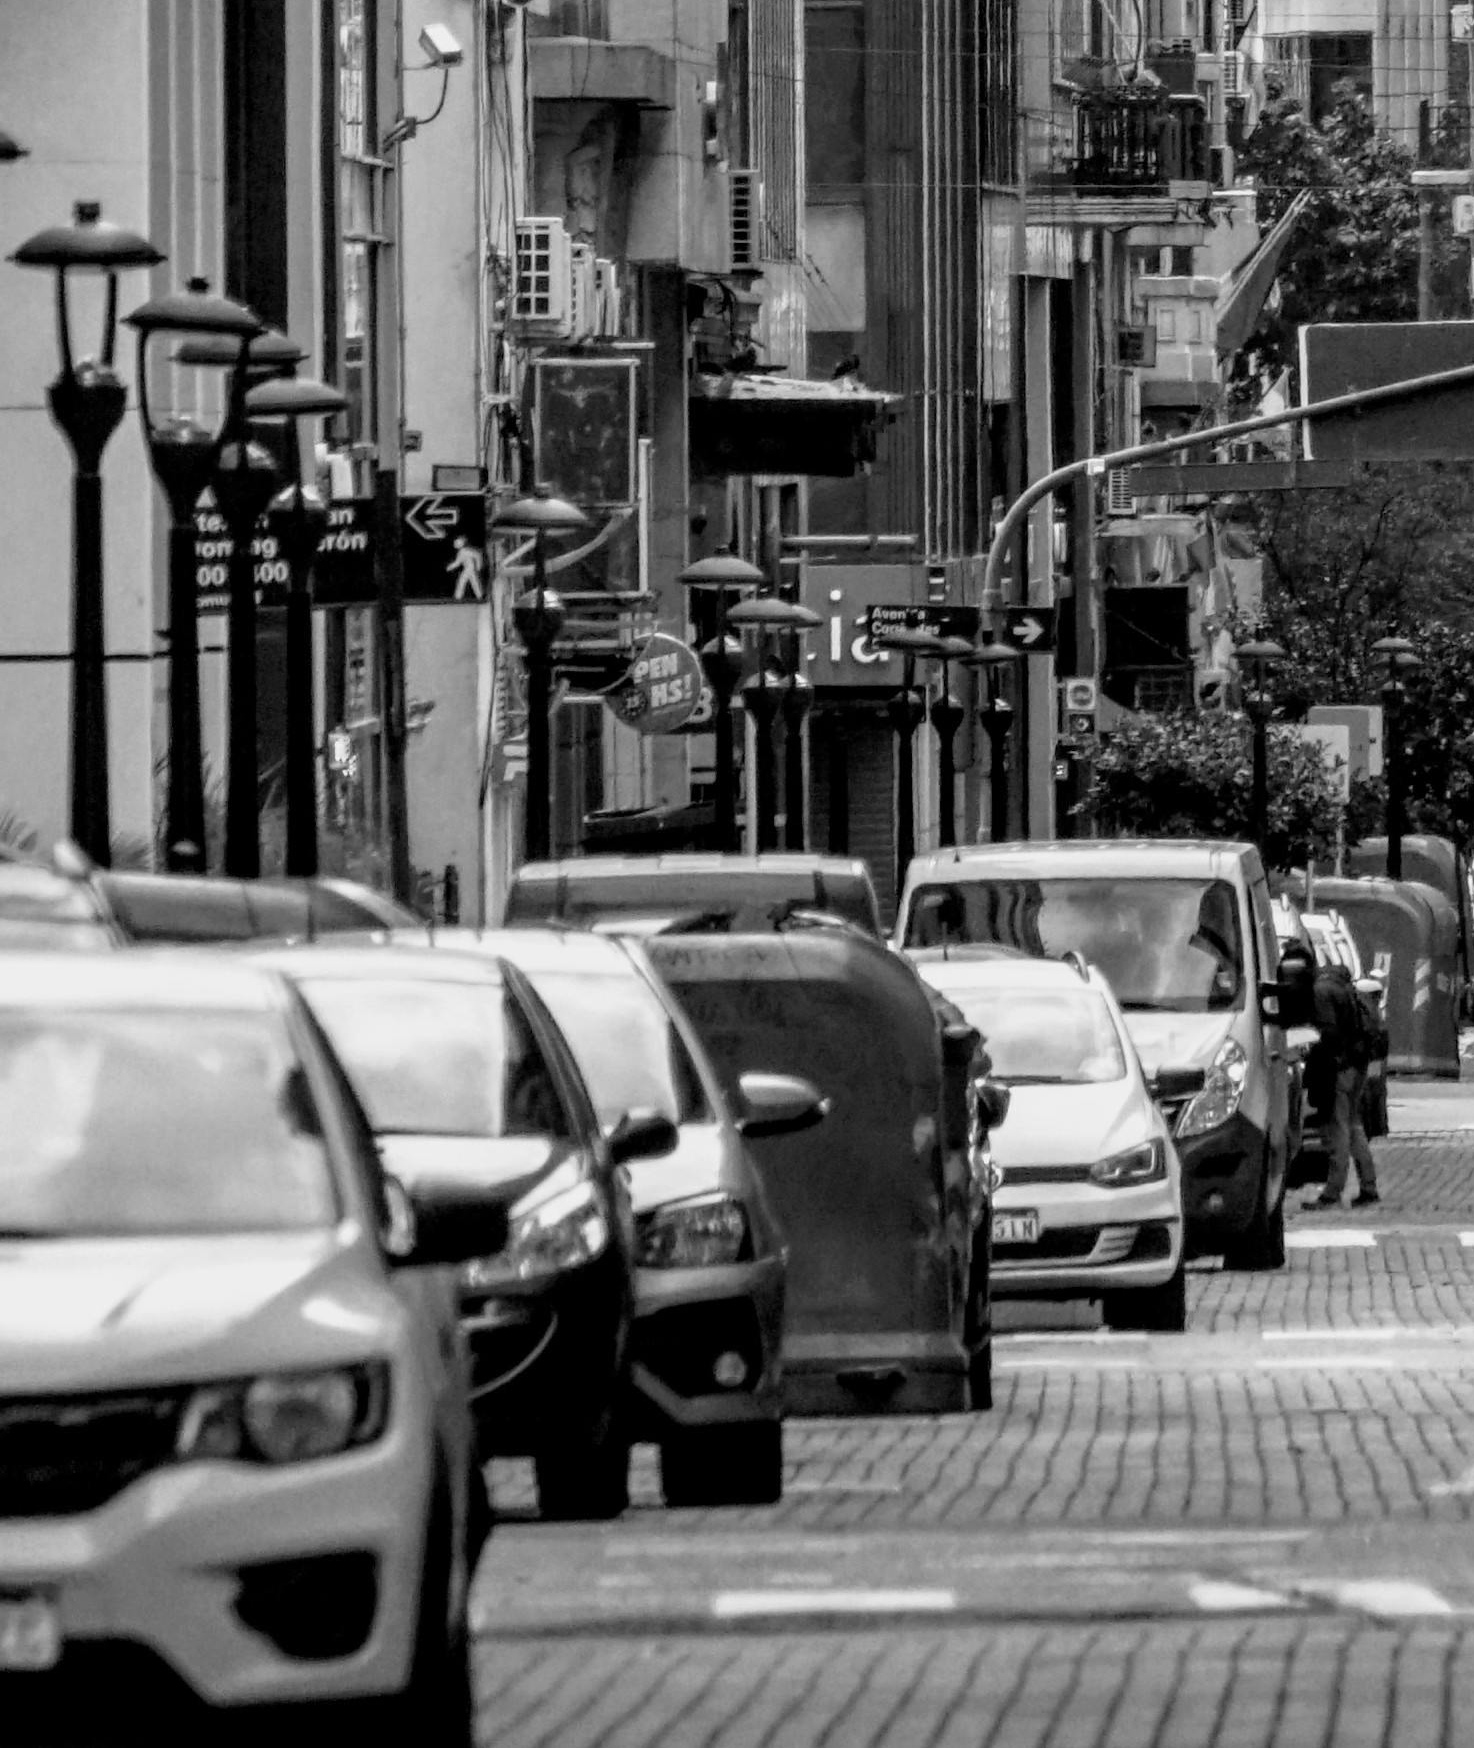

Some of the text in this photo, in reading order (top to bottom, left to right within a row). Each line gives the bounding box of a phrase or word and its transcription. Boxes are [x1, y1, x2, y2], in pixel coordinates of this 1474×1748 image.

[196, 513, 228, 532] te.
[316, 528, 368, 553] rón
[196, 563, 228, 587] 00
[871, 607, 926, 621] Avena
[633, 652, 677, 684] PEN
